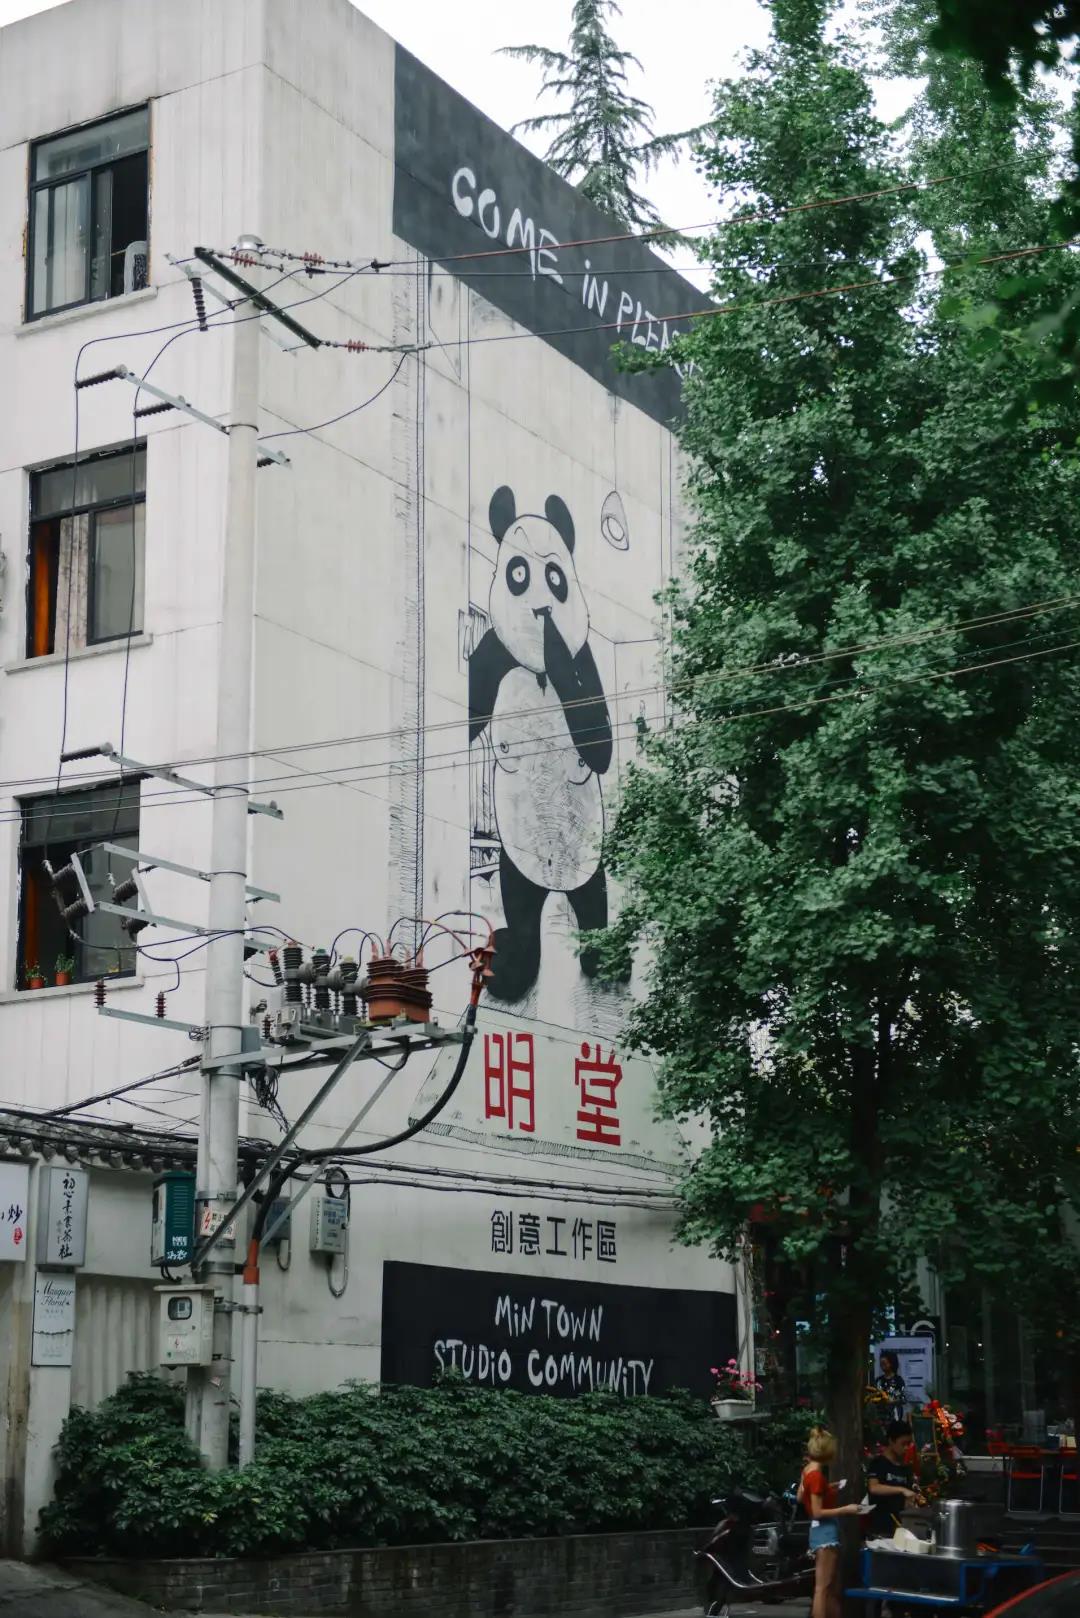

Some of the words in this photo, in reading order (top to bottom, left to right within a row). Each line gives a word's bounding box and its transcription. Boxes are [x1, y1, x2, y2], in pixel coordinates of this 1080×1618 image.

[452, 167, 564, 285] COME
[490, 1210, 617, 1263] 創意工作區
[541, 1300, 603, 1342] TOWN
